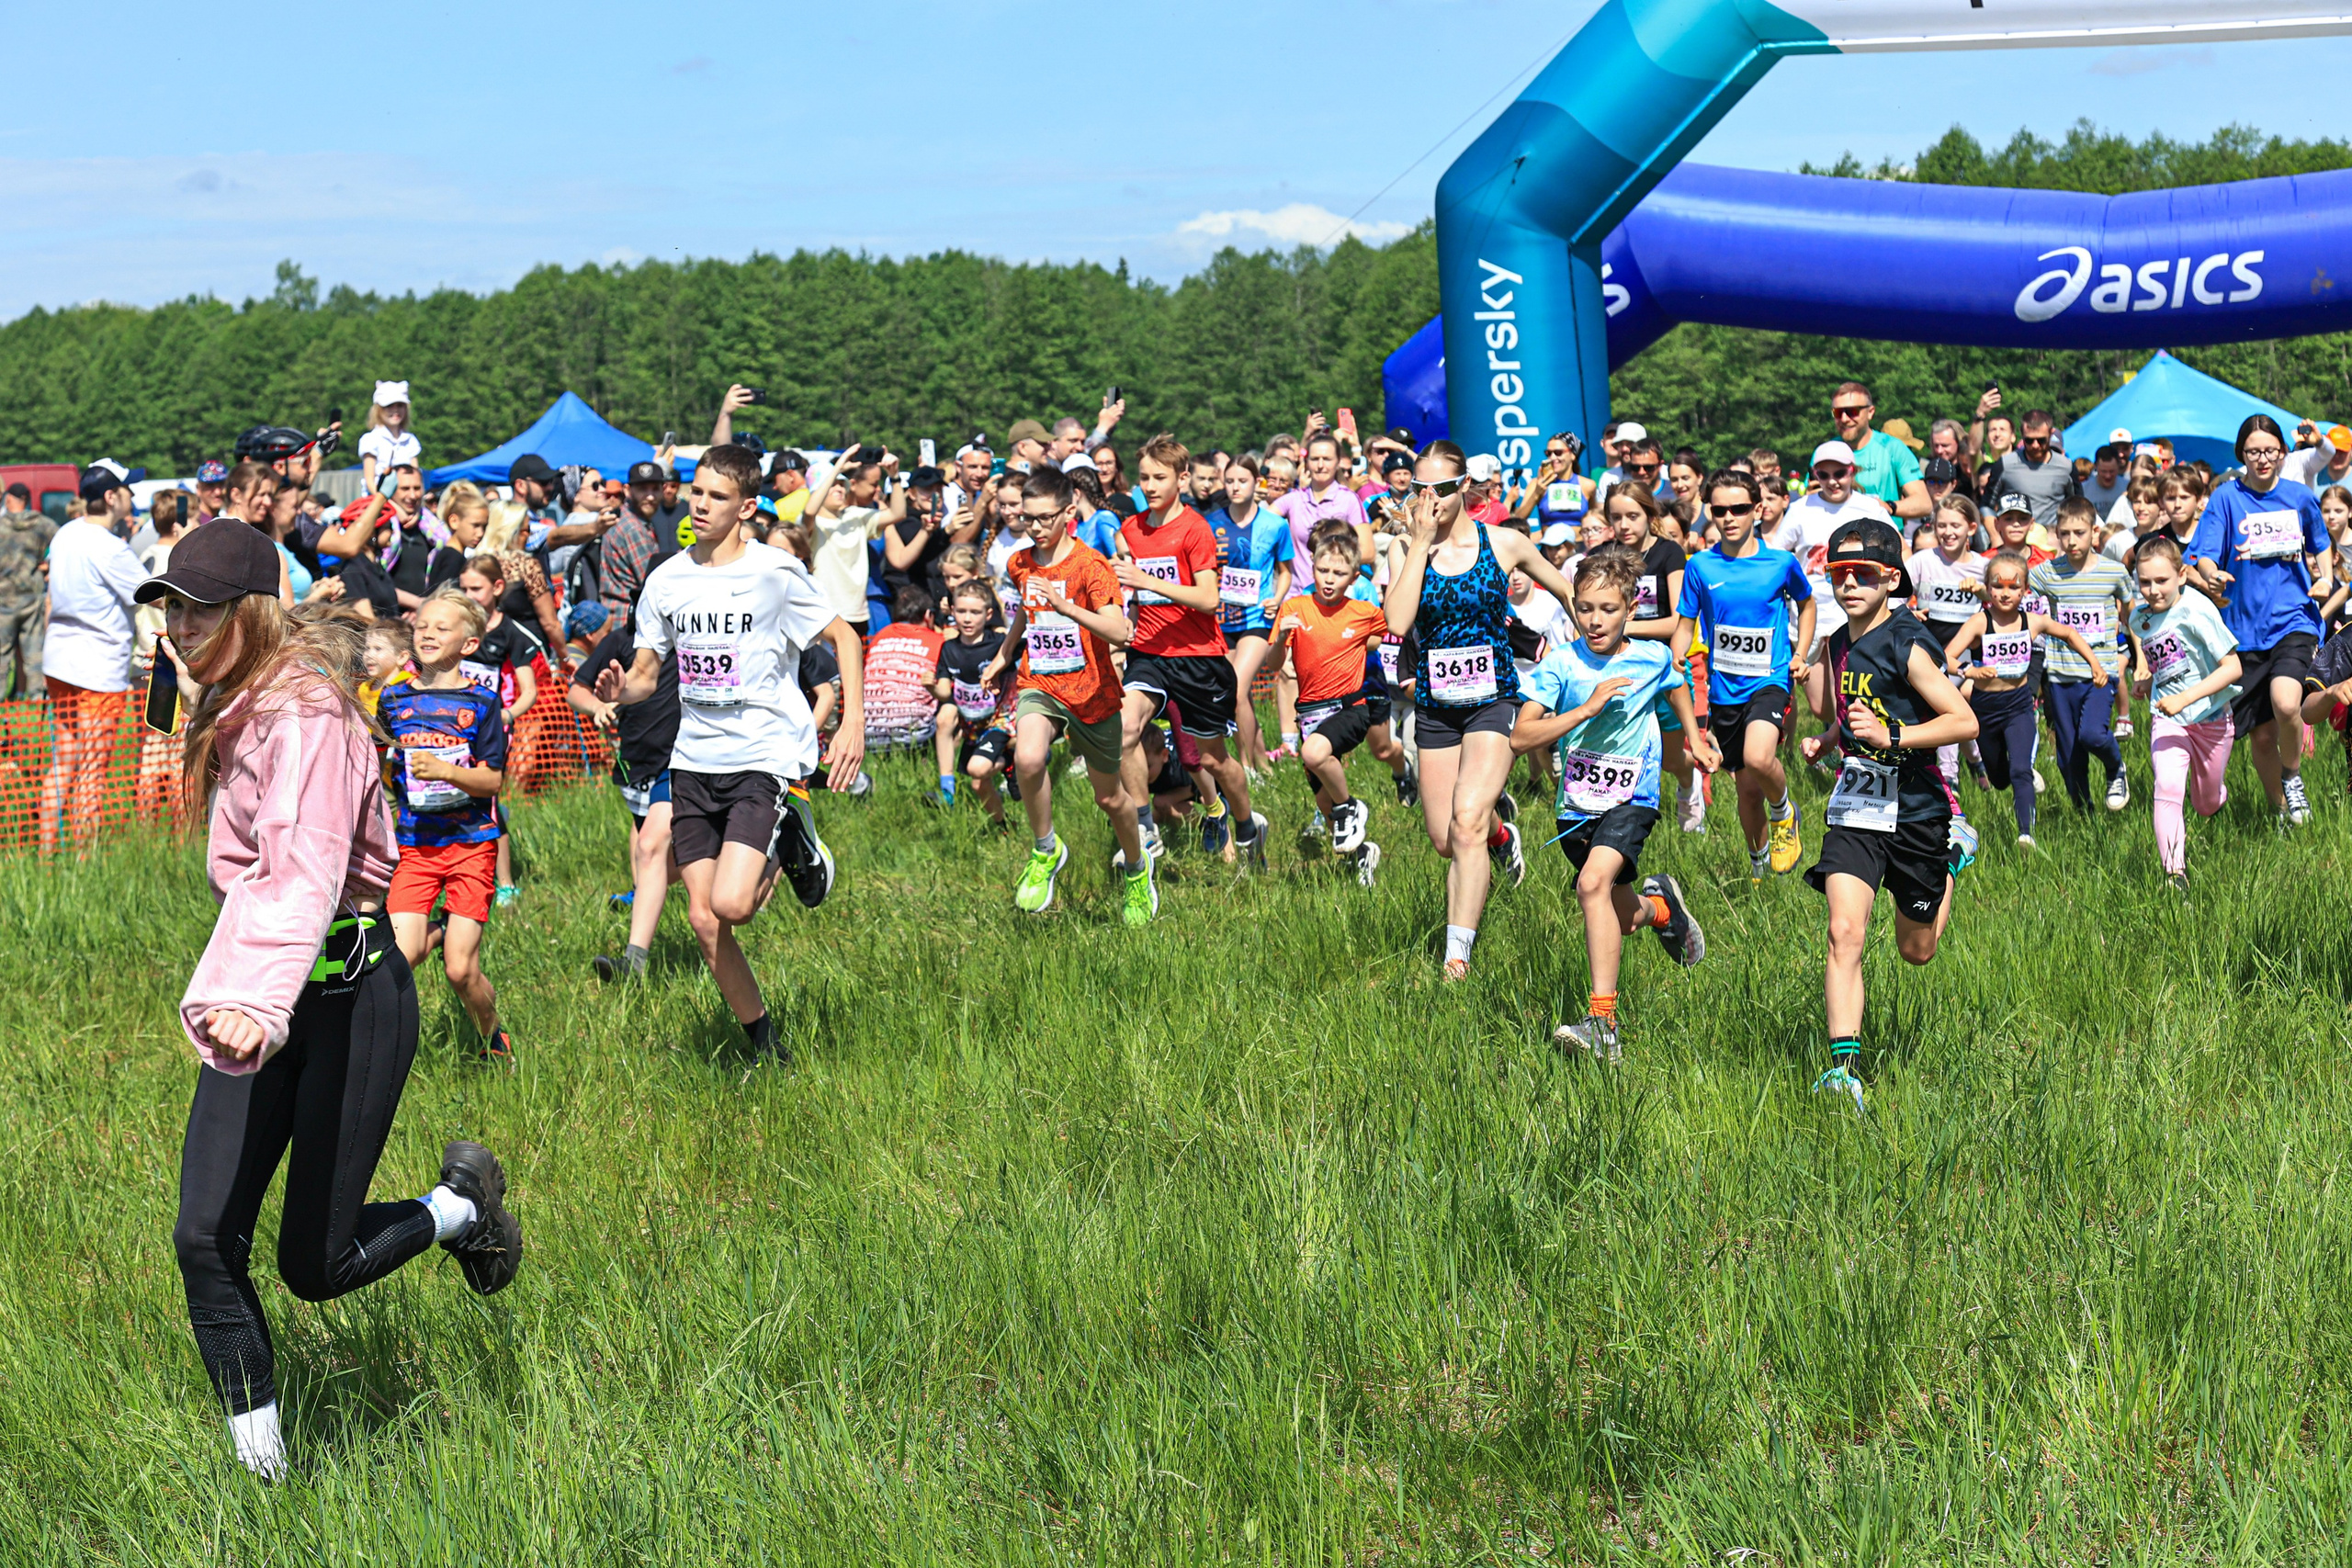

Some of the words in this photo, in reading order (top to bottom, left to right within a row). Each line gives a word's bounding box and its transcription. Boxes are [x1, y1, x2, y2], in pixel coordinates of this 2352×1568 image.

[1474, 258, 1540, 526] aspersky
[2253, 520, 2294, 536] 3556
[1141, 566, 1176, 581] 609
[1225, 574, 1256, 589] 3559
[1934, 587, 1974, 604] 9239
[667, 613, 752, 634] UNNER
[2063, 611, 2099, 626] 3591
[1033, 634, 1076, 650] 3565
[1719, 632, 1767, 654] 9930
[1987, 641, 2029, 658] 3503
[682, 653, 733, 675] 3539
[1435, 656, 1488, 679] 3618
[1840, 671, 1873, 696] ELK
[1571, 761, 1634, 787] 3598
[328, 986, 356, 995] DEMIX
